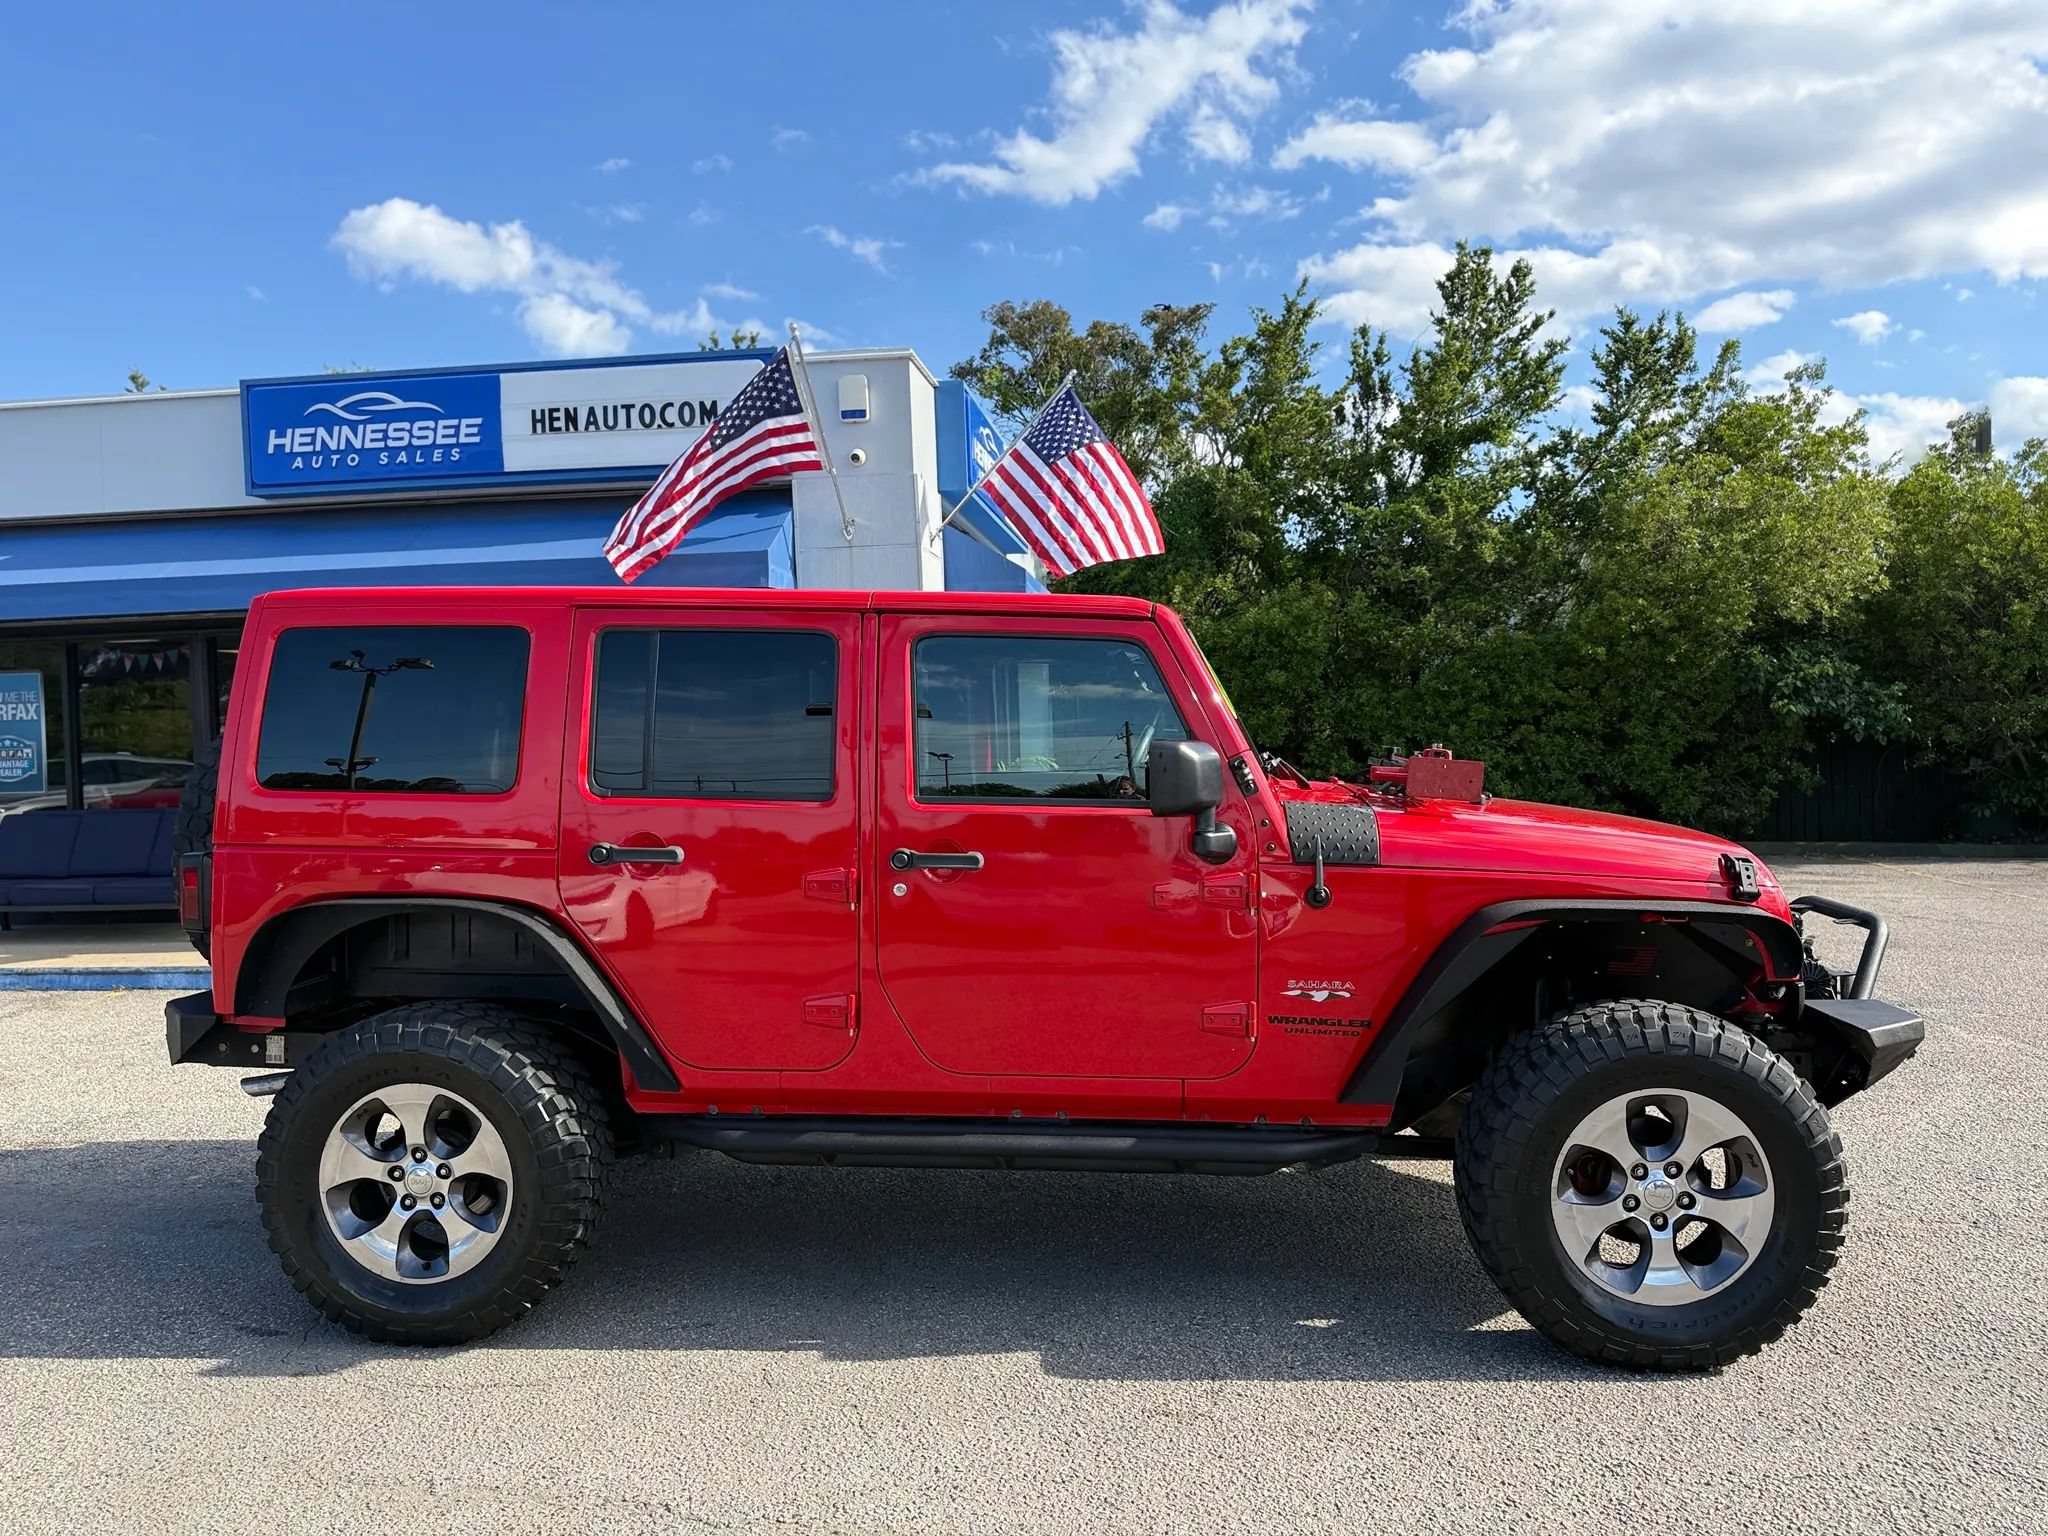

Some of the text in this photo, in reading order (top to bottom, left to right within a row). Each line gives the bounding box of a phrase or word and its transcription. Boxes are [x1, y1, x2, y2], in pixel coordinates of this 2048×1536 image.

[267, 417, 483, 454] HENNESSEE
[291, 447, 460, 470] AUTO SALES
[5, 691, 19, 702] ME
[20, 690, 37, 702] THE
[1287, 980, 1355, 990] SAHARA
[1268, 1016, 1373, 1029] WRANGLER
[1284, 1028, 1361, 1037] UNLIMITED
